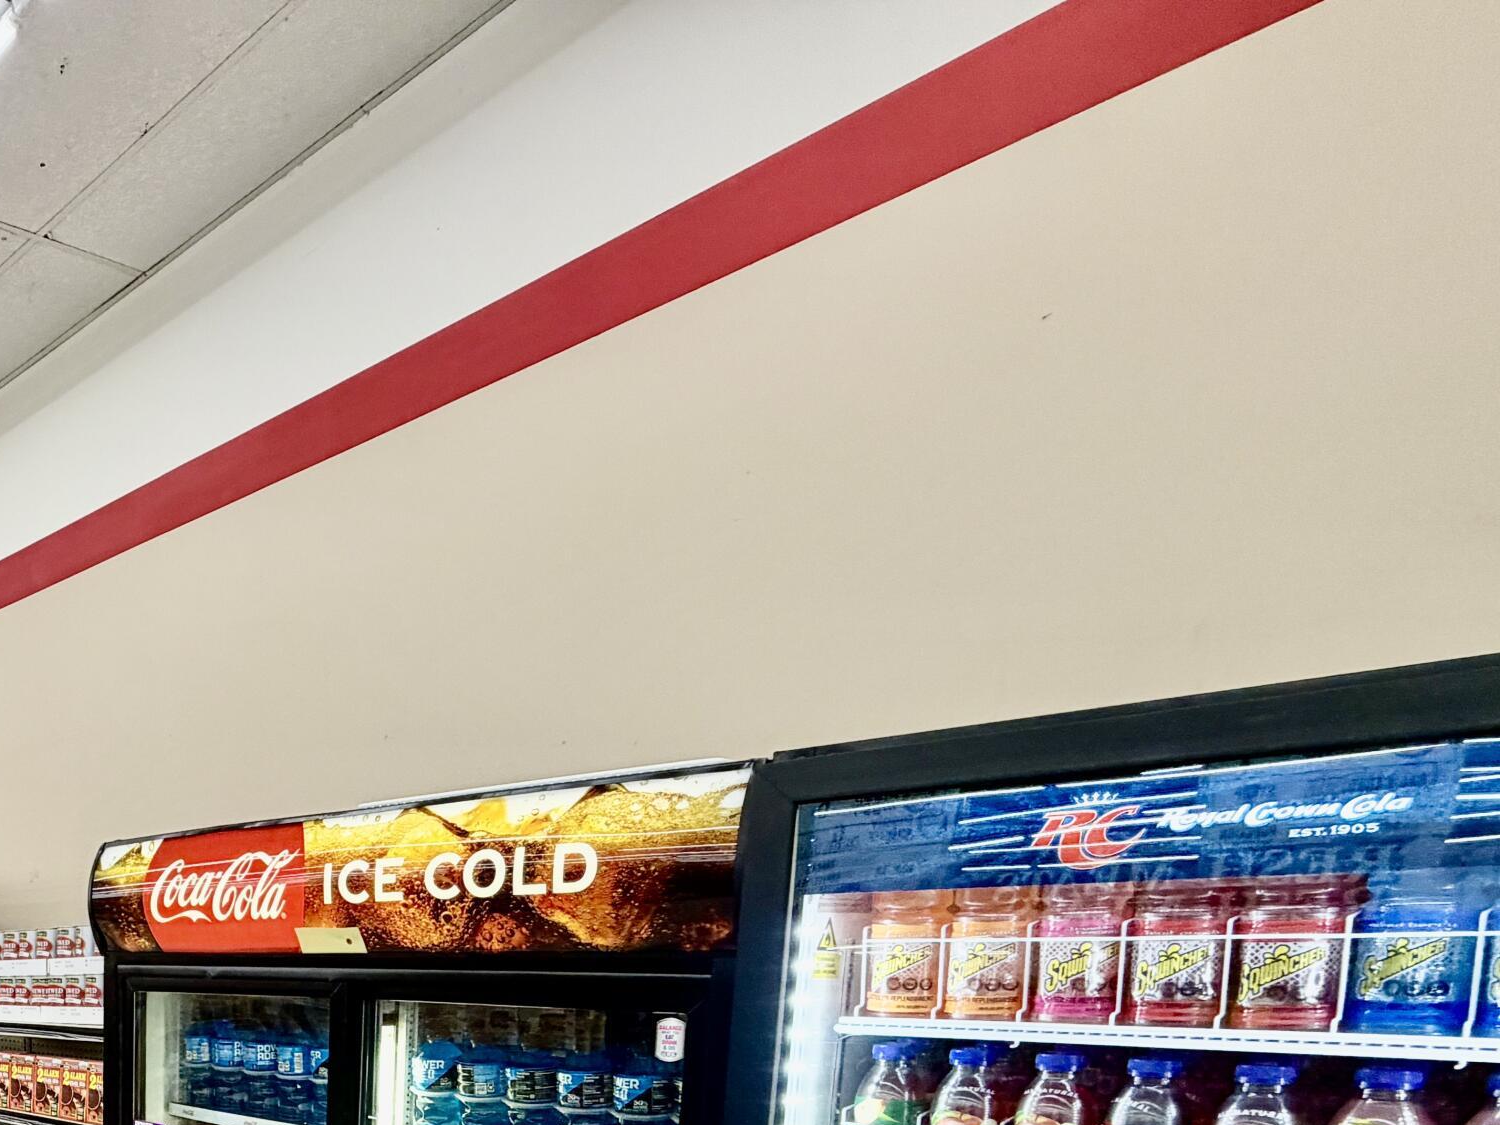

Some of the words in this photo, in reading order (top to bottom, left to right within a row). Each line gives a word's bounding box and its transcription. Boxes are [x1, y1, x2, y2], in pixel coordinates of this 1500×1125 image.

[1031, 804, 1147, 870] RC
[1156, 803, 1252, 833] Royal
[1244, 800, 1342, 828] Crown
[1340, 792, 1415, 821] Cola
[149, 847, 299, 923] Coca-Cola
[322, 858, 404, 905] ICE
[424, 842, 598, 897] COLD
